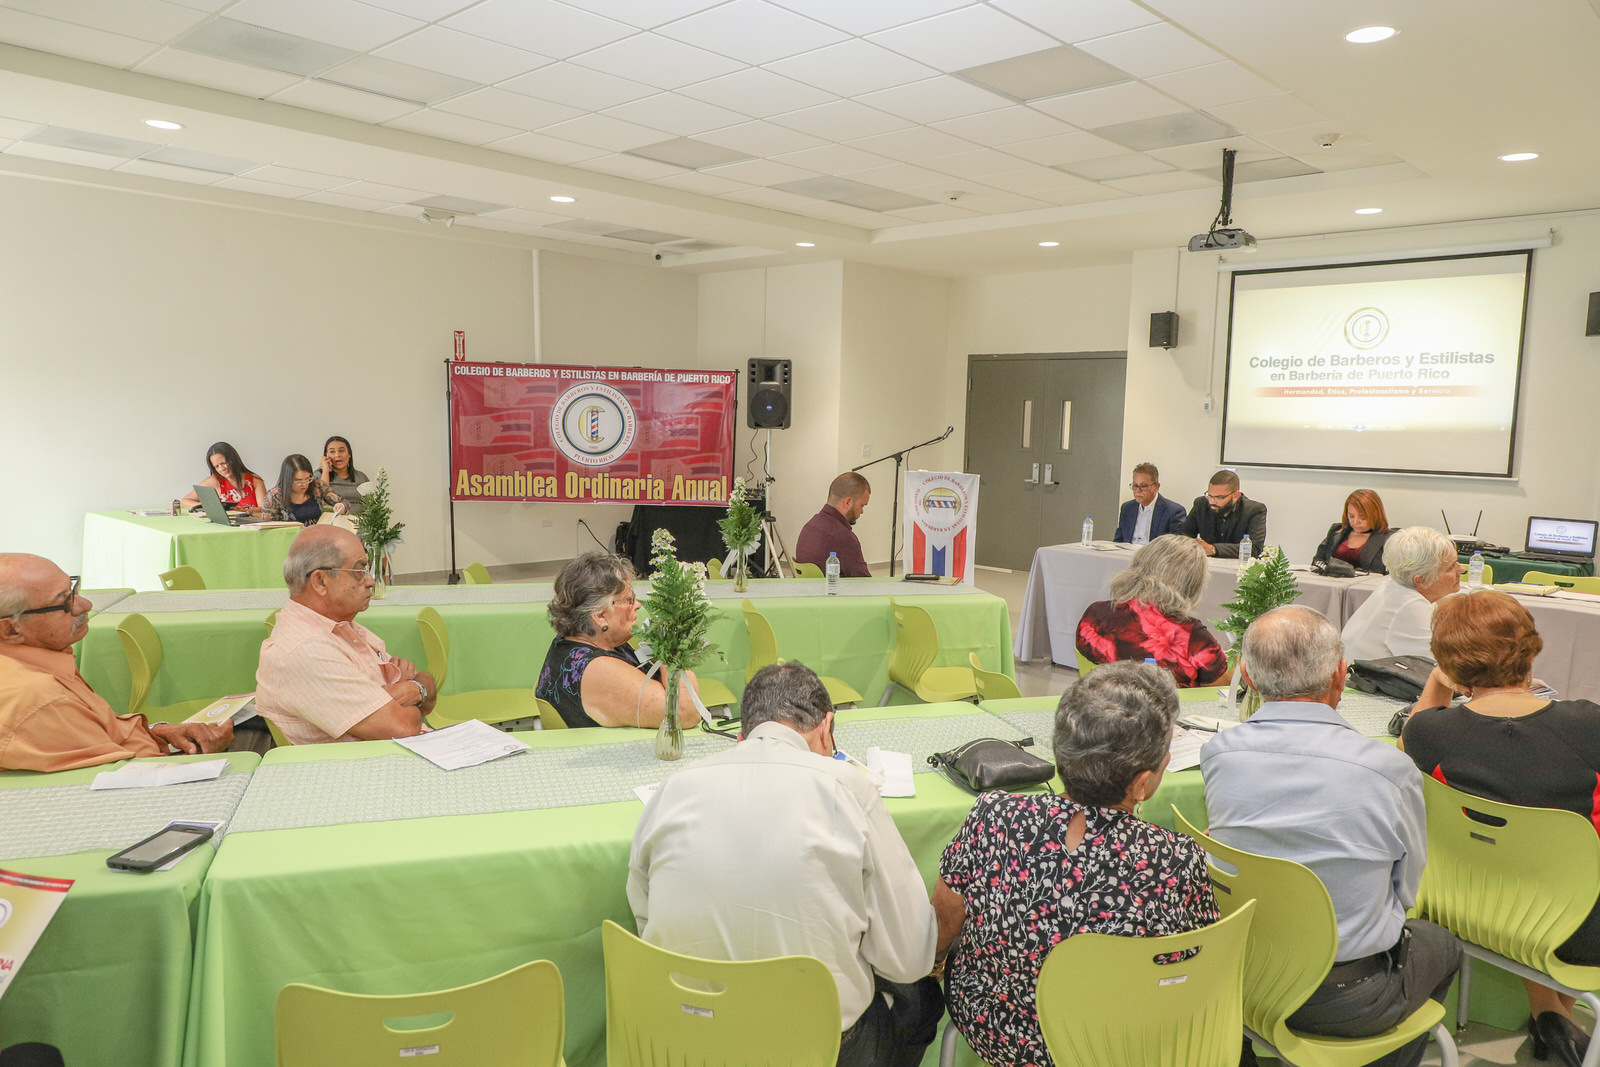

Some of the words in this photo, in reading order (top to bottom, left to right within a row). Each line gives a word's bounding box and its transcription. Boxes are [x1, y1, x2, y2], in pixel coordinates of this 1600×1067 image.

[1249, 355, 1303, 370] Colegio
[1307, 355, 1325, 367] de
[1330, 354, 1400, 367] Barberos
[1405, 355, 1415, 368] y
[1419, 351, 1495, 365] Estilistas
[454, 365, 491, 377] COLEGIO
[492, 367, 504, 377] DE
[505, 367, 551, 378] BARBEROS
[553, 369, 559, 379] Y
[560, 369, 606, 380] ESTILISTAS
[608, 371, 619, 381] EN
[621, 370, 663, 382] BARBERÍA
[664, 372, 676, 382] DE
[677, 373, 710, 384] PUERTO
[711, 374, 731, 385] RICO
[1270, 372, 1285, 381] en
[1289, 369, 1343, 381] Barbería
[1347, 369, 1364, 380] de
[1368, 369, 1413, 380] Puerto
[1418, 368, 1450, 379] Rico
[455, 468, 558, 498] Asamblea
[564, 471, 665, 500] Ordinaria
[671, 474, 728, 501] Anual
